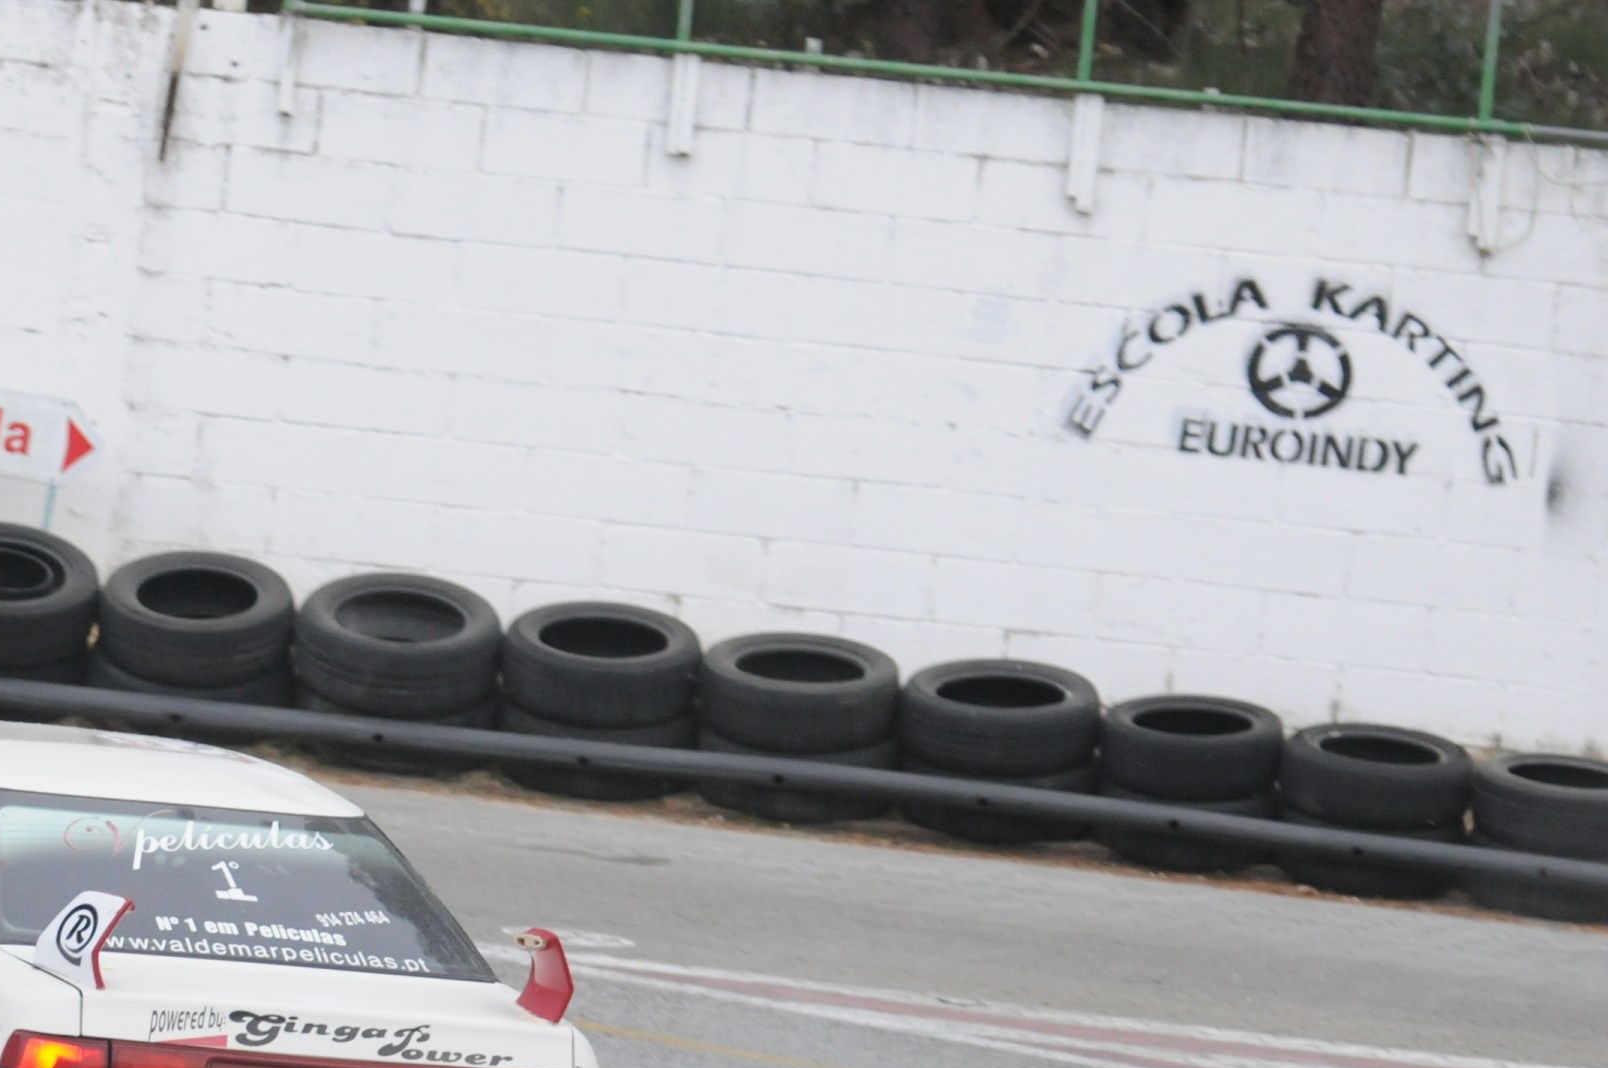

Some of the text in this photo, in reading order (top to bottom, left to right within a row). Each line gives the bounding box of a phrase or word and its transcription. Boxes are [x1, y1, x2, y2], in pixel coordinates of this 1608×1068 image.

[1065, 277, 1519, 487] ESCOLA KARTING
[1177, 417, 1420, 476] EUROINDY
[184, 917, 197, 933] 1
[204, 919, 240, 936] em
[148, 1005, 227, 1042] powered by:
[229, 1010, 514, 1067] Ginga Power
